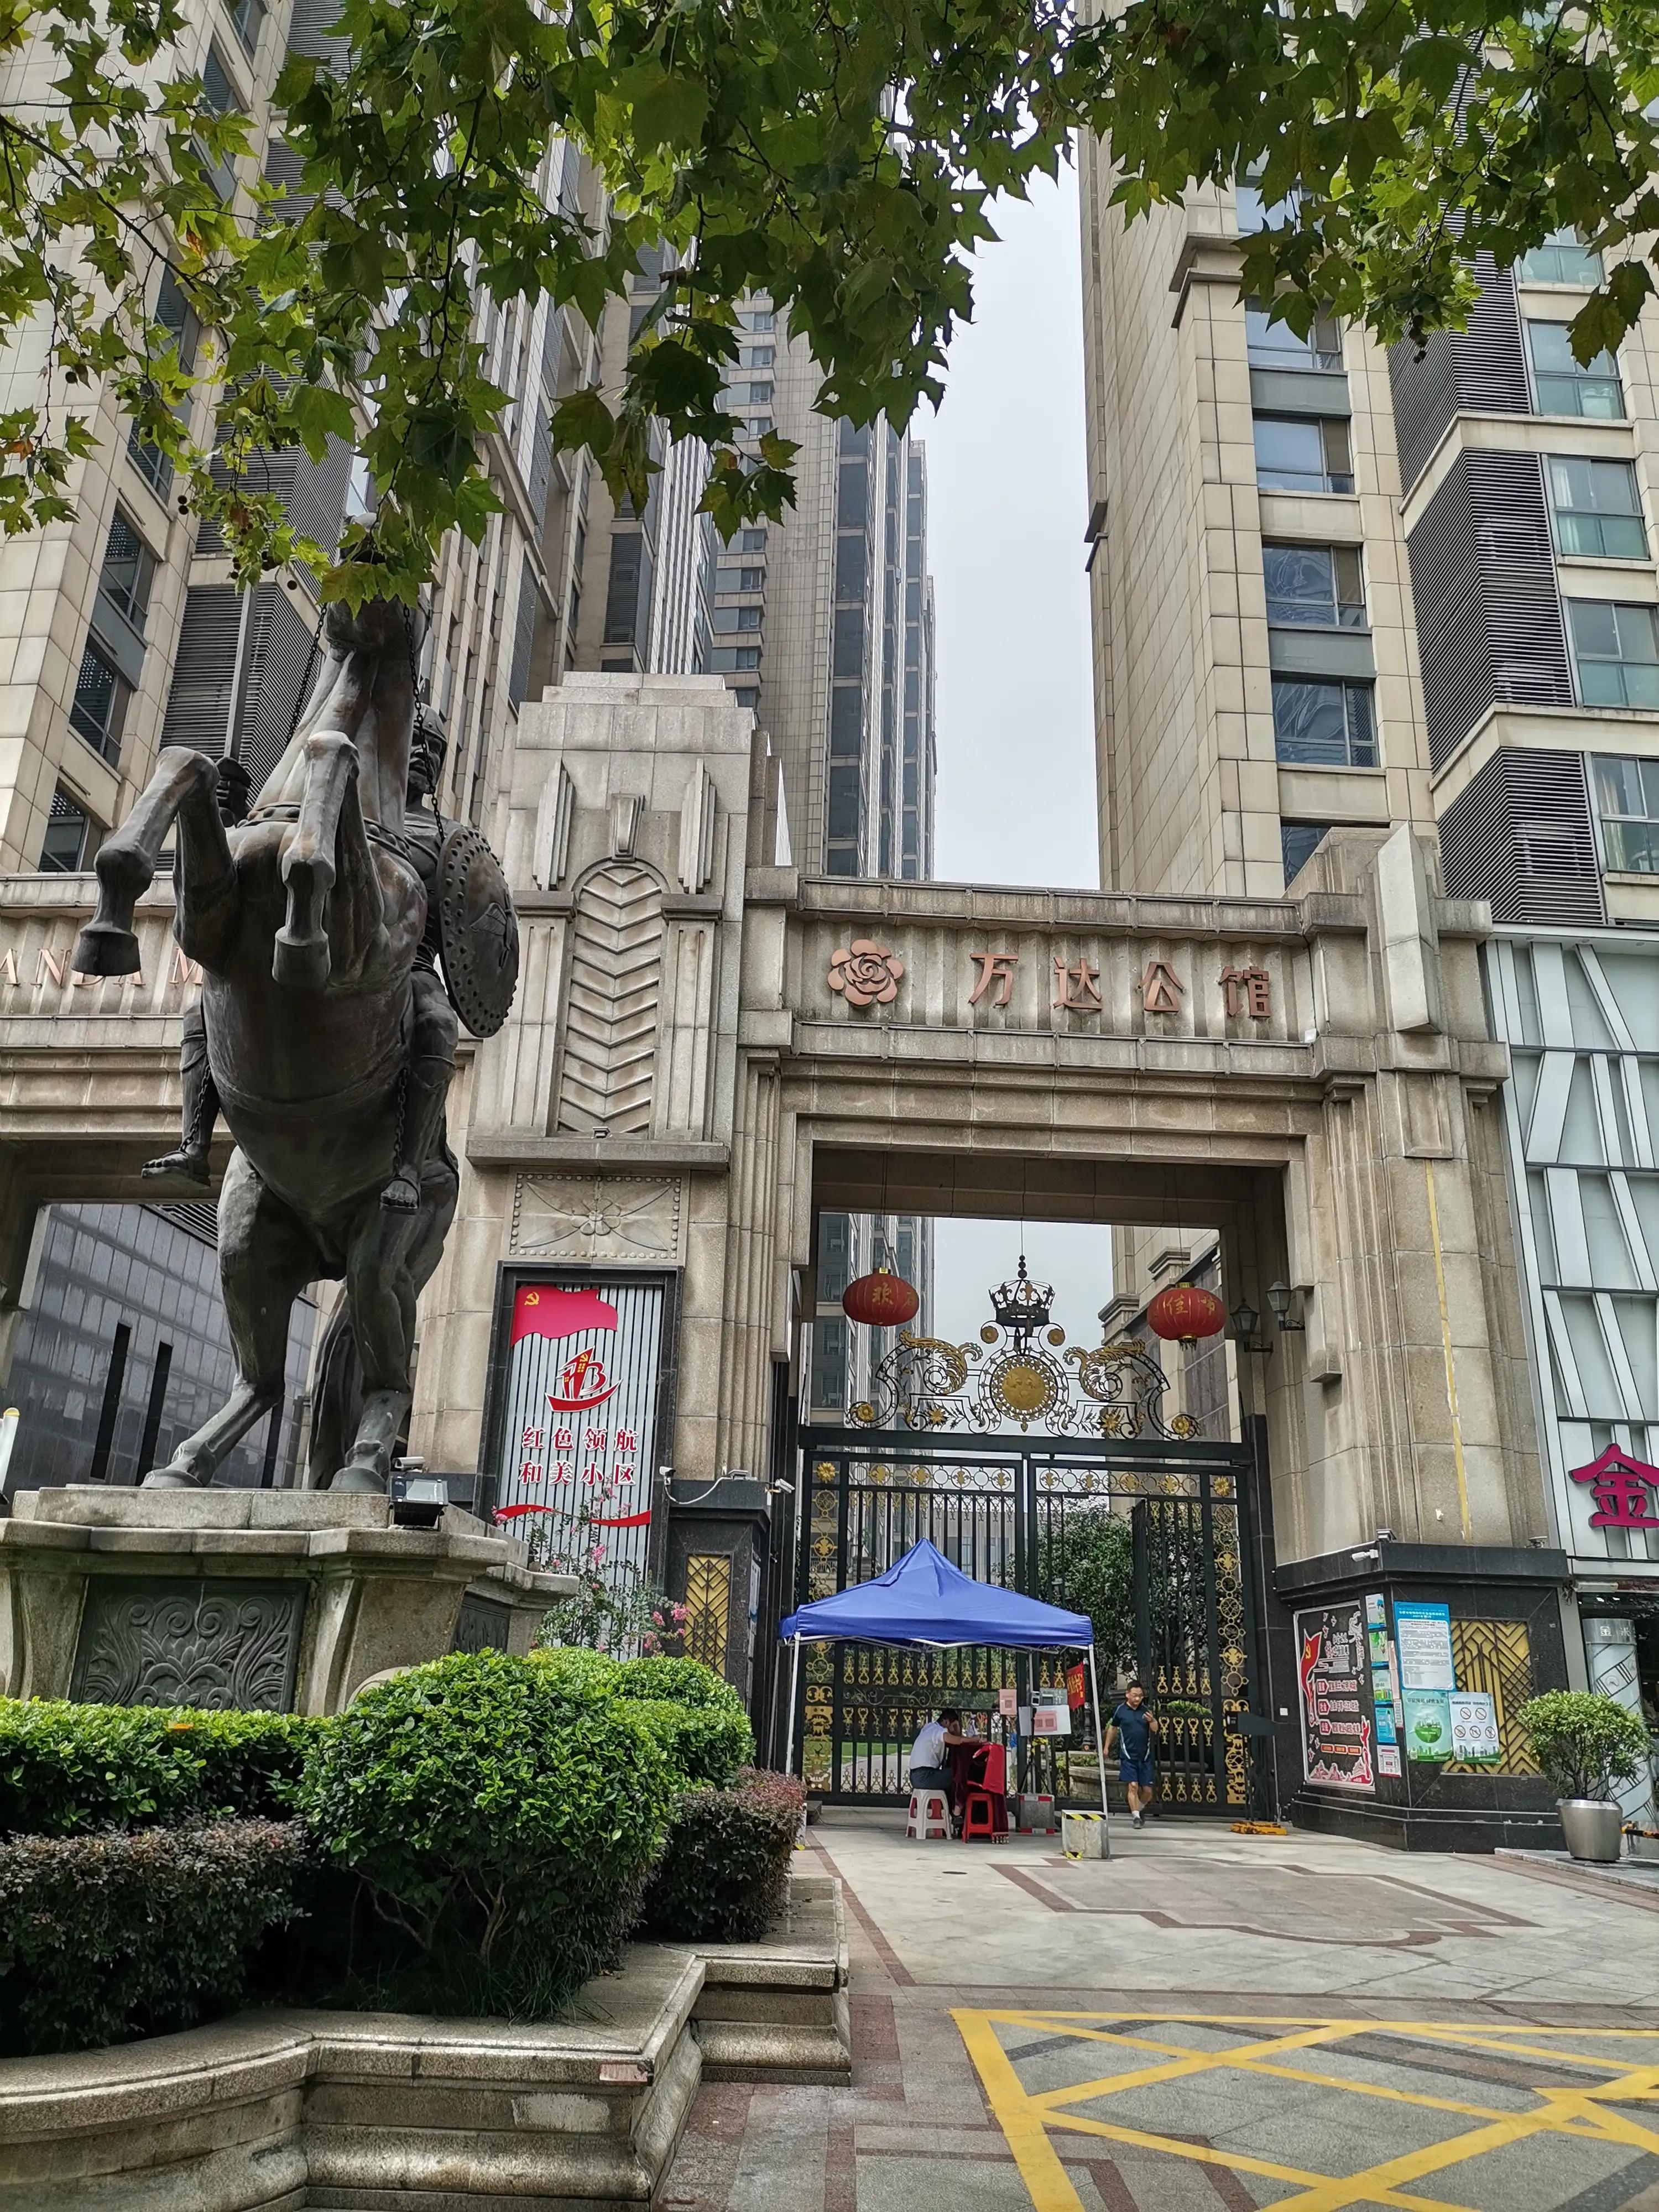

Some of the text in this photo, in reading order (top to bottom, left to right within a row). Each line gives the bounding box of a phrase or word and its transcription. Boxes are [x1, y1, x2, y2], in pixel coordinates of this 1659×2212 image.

[969, 952, 1271, 1018] 万达公馆
[522, 1426, 639, 1452] 红色领航
[518, 1459, 637, 1486] 和美小区
[1568, 1443, 1659, 1528] 金
